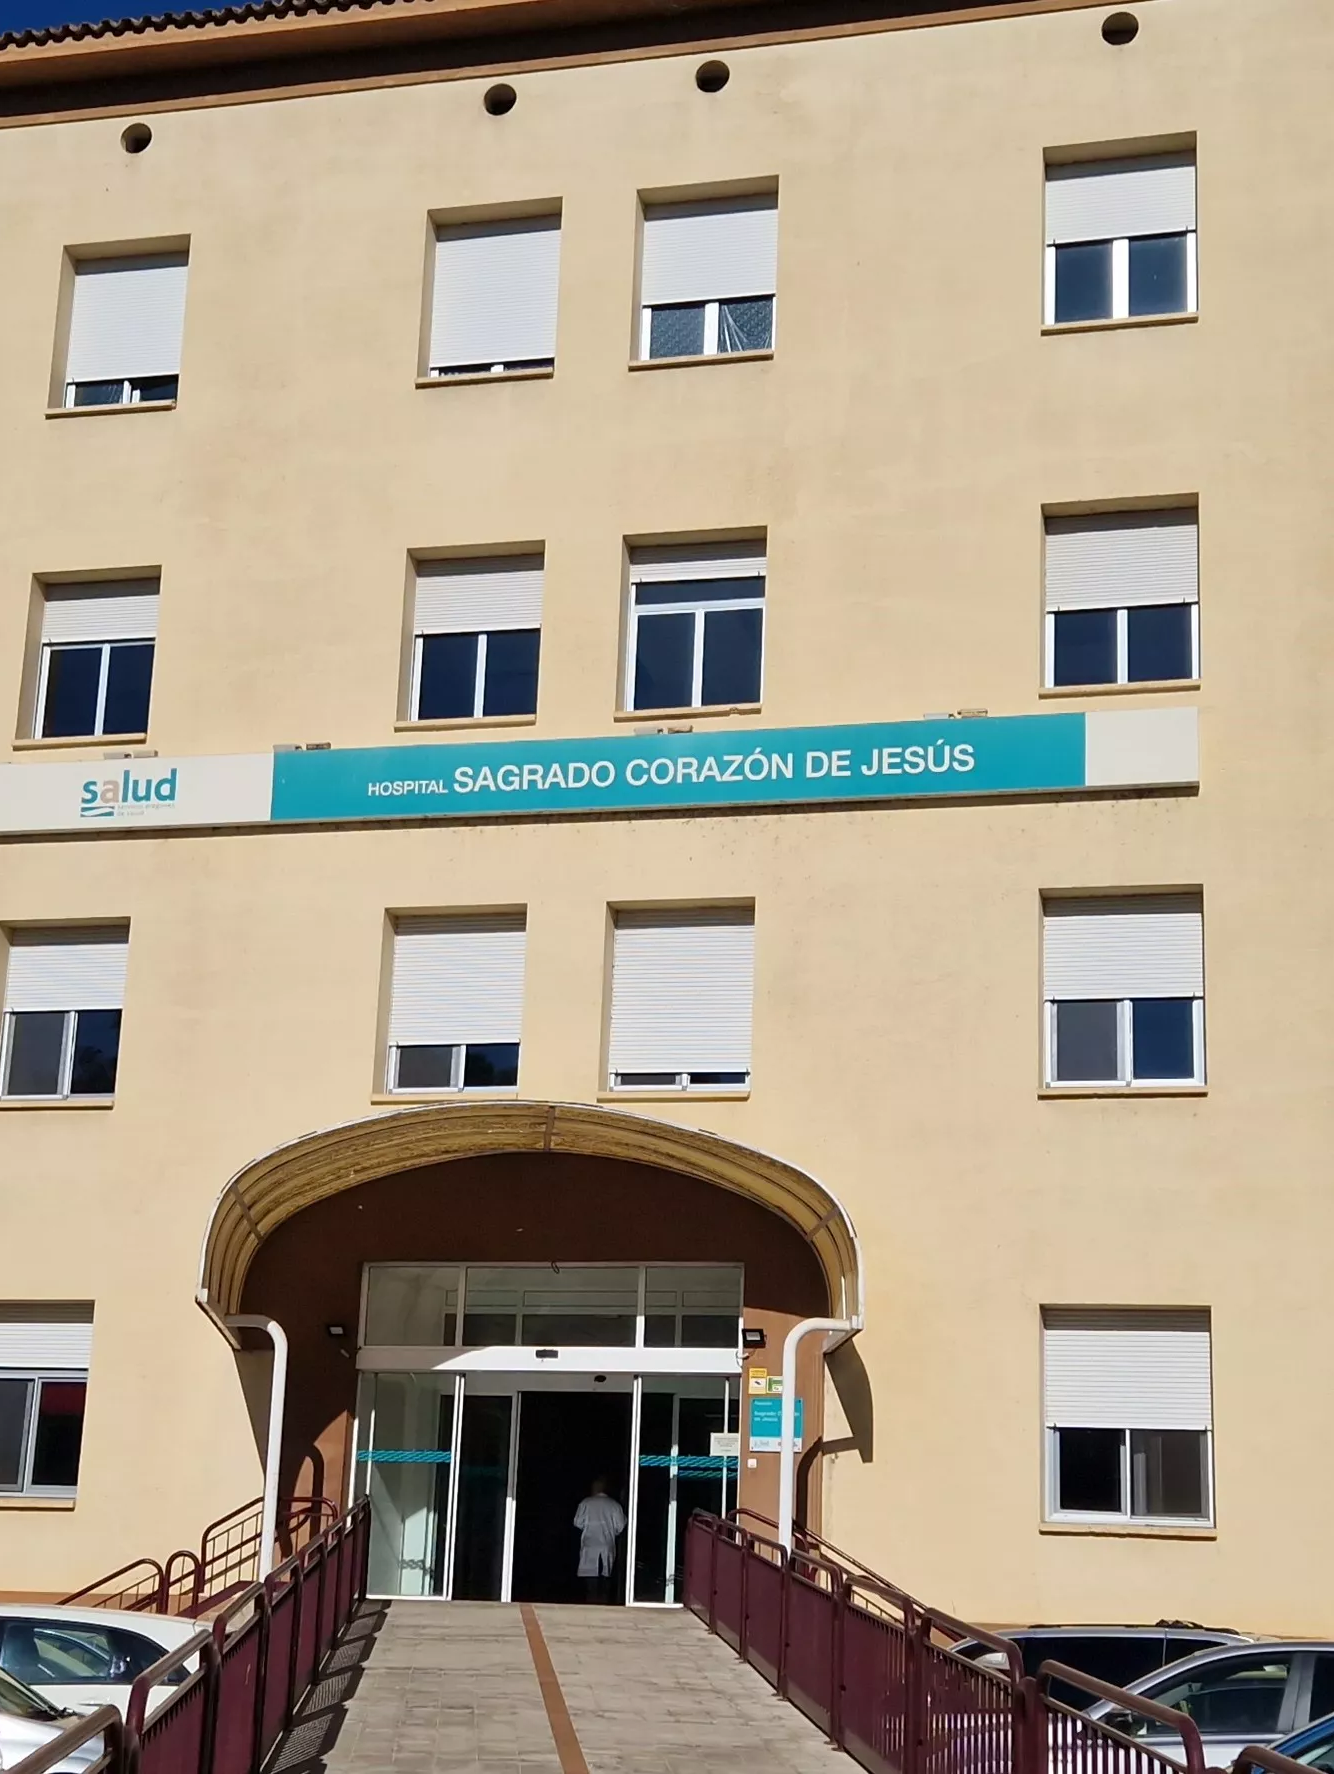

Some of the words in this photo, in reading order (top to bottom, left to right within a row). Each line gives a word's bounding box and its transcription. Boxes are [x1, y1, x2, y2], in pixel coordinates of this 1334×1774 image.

[81, 767, 177, 804] salud
[367, 779, 448, 797] HOSPITAL
[453, 760, 616, 794] SAGRADO
[625, 747, 793, 786] CORAZÓN
[806, 750, 851, 779] DE
[861, 739, 975, 776] JESÚS
